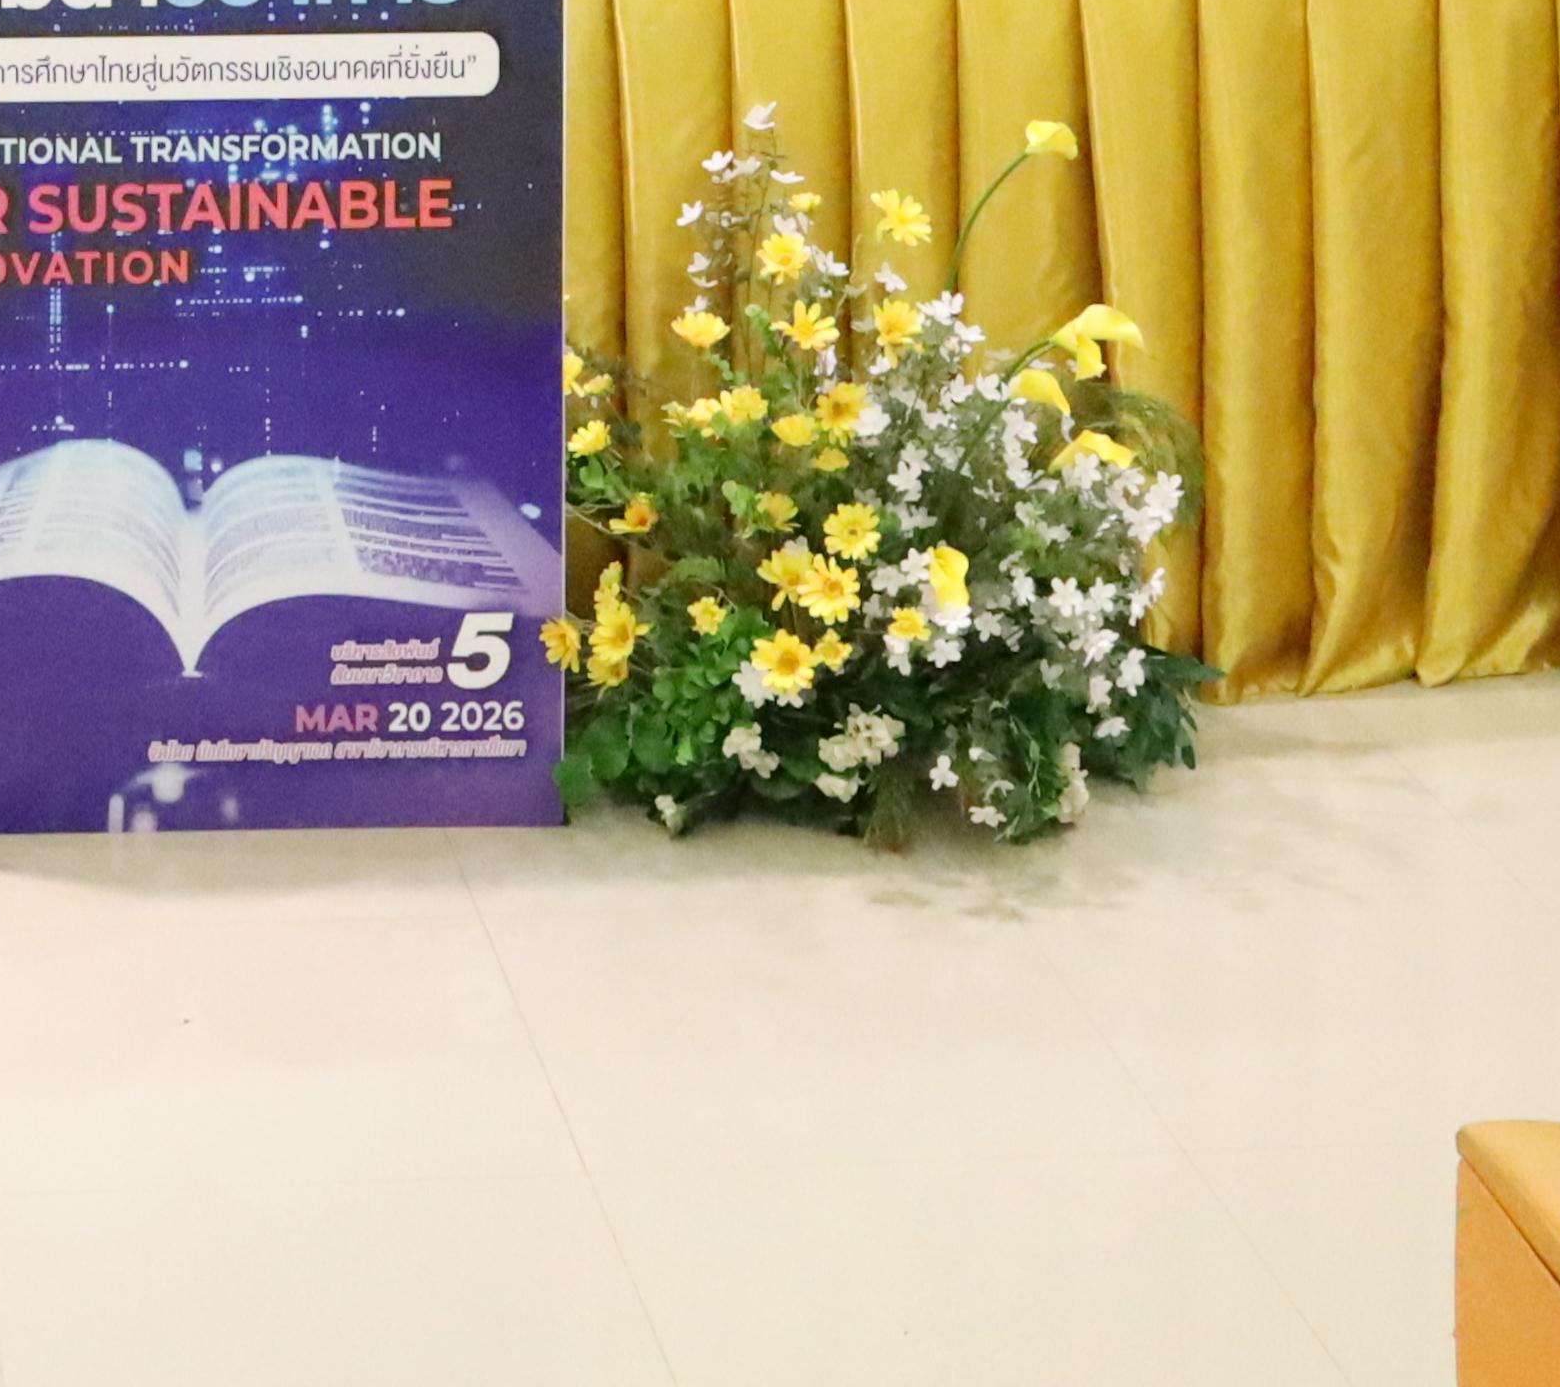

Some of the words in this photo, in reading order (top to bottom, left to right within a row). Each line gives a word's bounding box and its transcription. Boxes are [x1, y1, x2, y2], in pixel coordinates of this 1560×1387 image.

[130, 131, 442, 164] TRANSFORMATION
[28, 178, 454, 235] SUSTAINABLE
[446, 612, 514, 690] 5
[295, 703, 379, 733] MAR
[388, 701, 432, 733] 20
[440, 700, 526, 733] 2026
